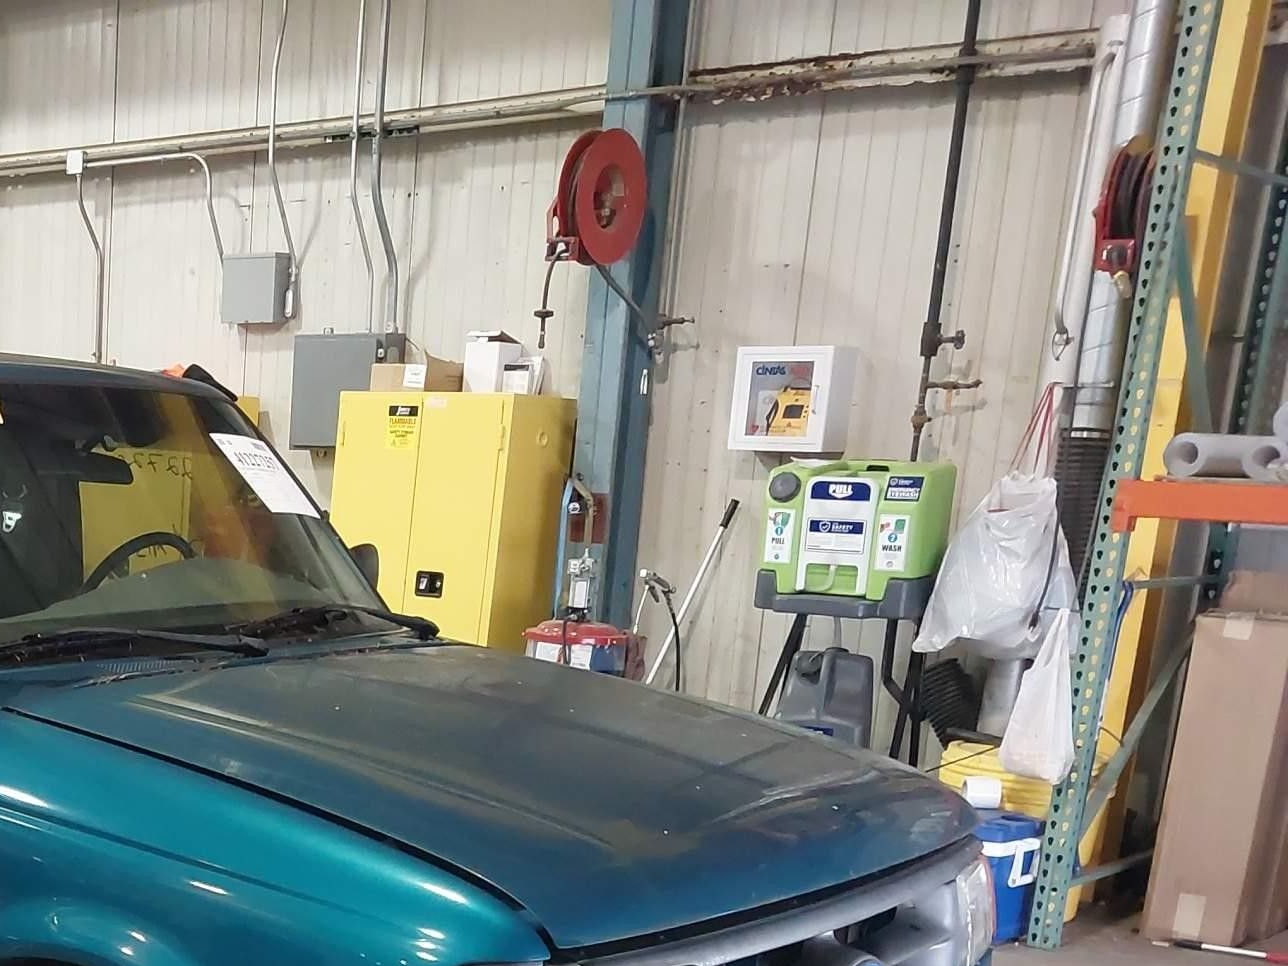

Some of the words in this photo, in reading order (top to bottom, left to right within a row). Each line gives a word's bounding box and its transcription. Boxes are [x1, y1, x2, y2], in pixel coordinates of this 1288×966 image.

[828, 484, 853, 495] PULL
[772, 537, 785, 545] PULL
[881, 544, 902, 553] WASH
